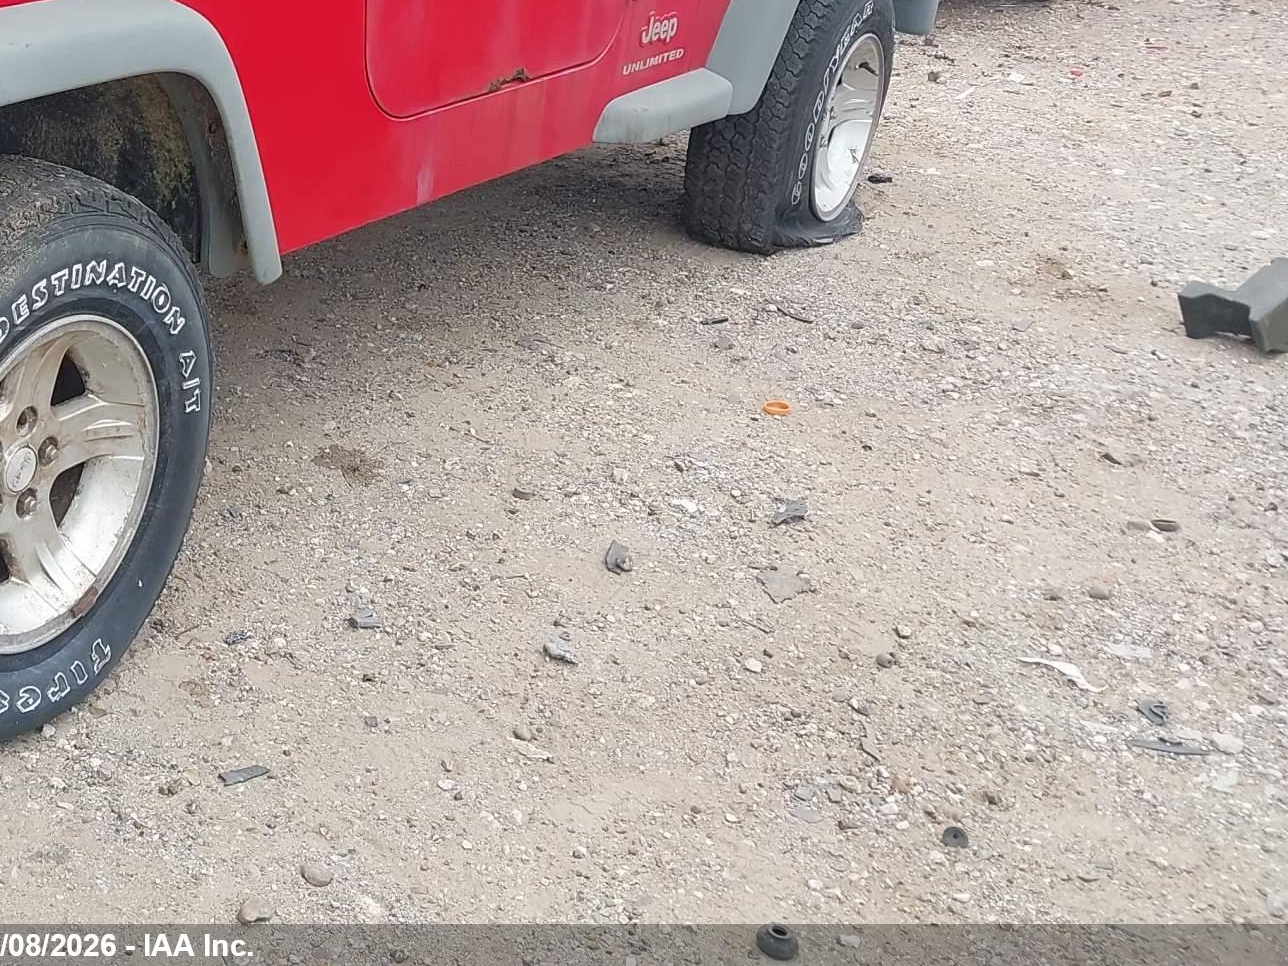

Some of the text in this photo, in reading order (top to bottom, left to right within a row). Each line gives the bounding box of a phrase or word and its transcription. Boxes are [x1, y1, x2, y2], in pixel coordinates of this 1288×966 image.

[640, 14, 679, 44] Jeep
[622, 48, 684, 75] UNLIMITED
[791, 0, 874, 206] GOODYEAR
[178, 349, 202, 414] A/T
